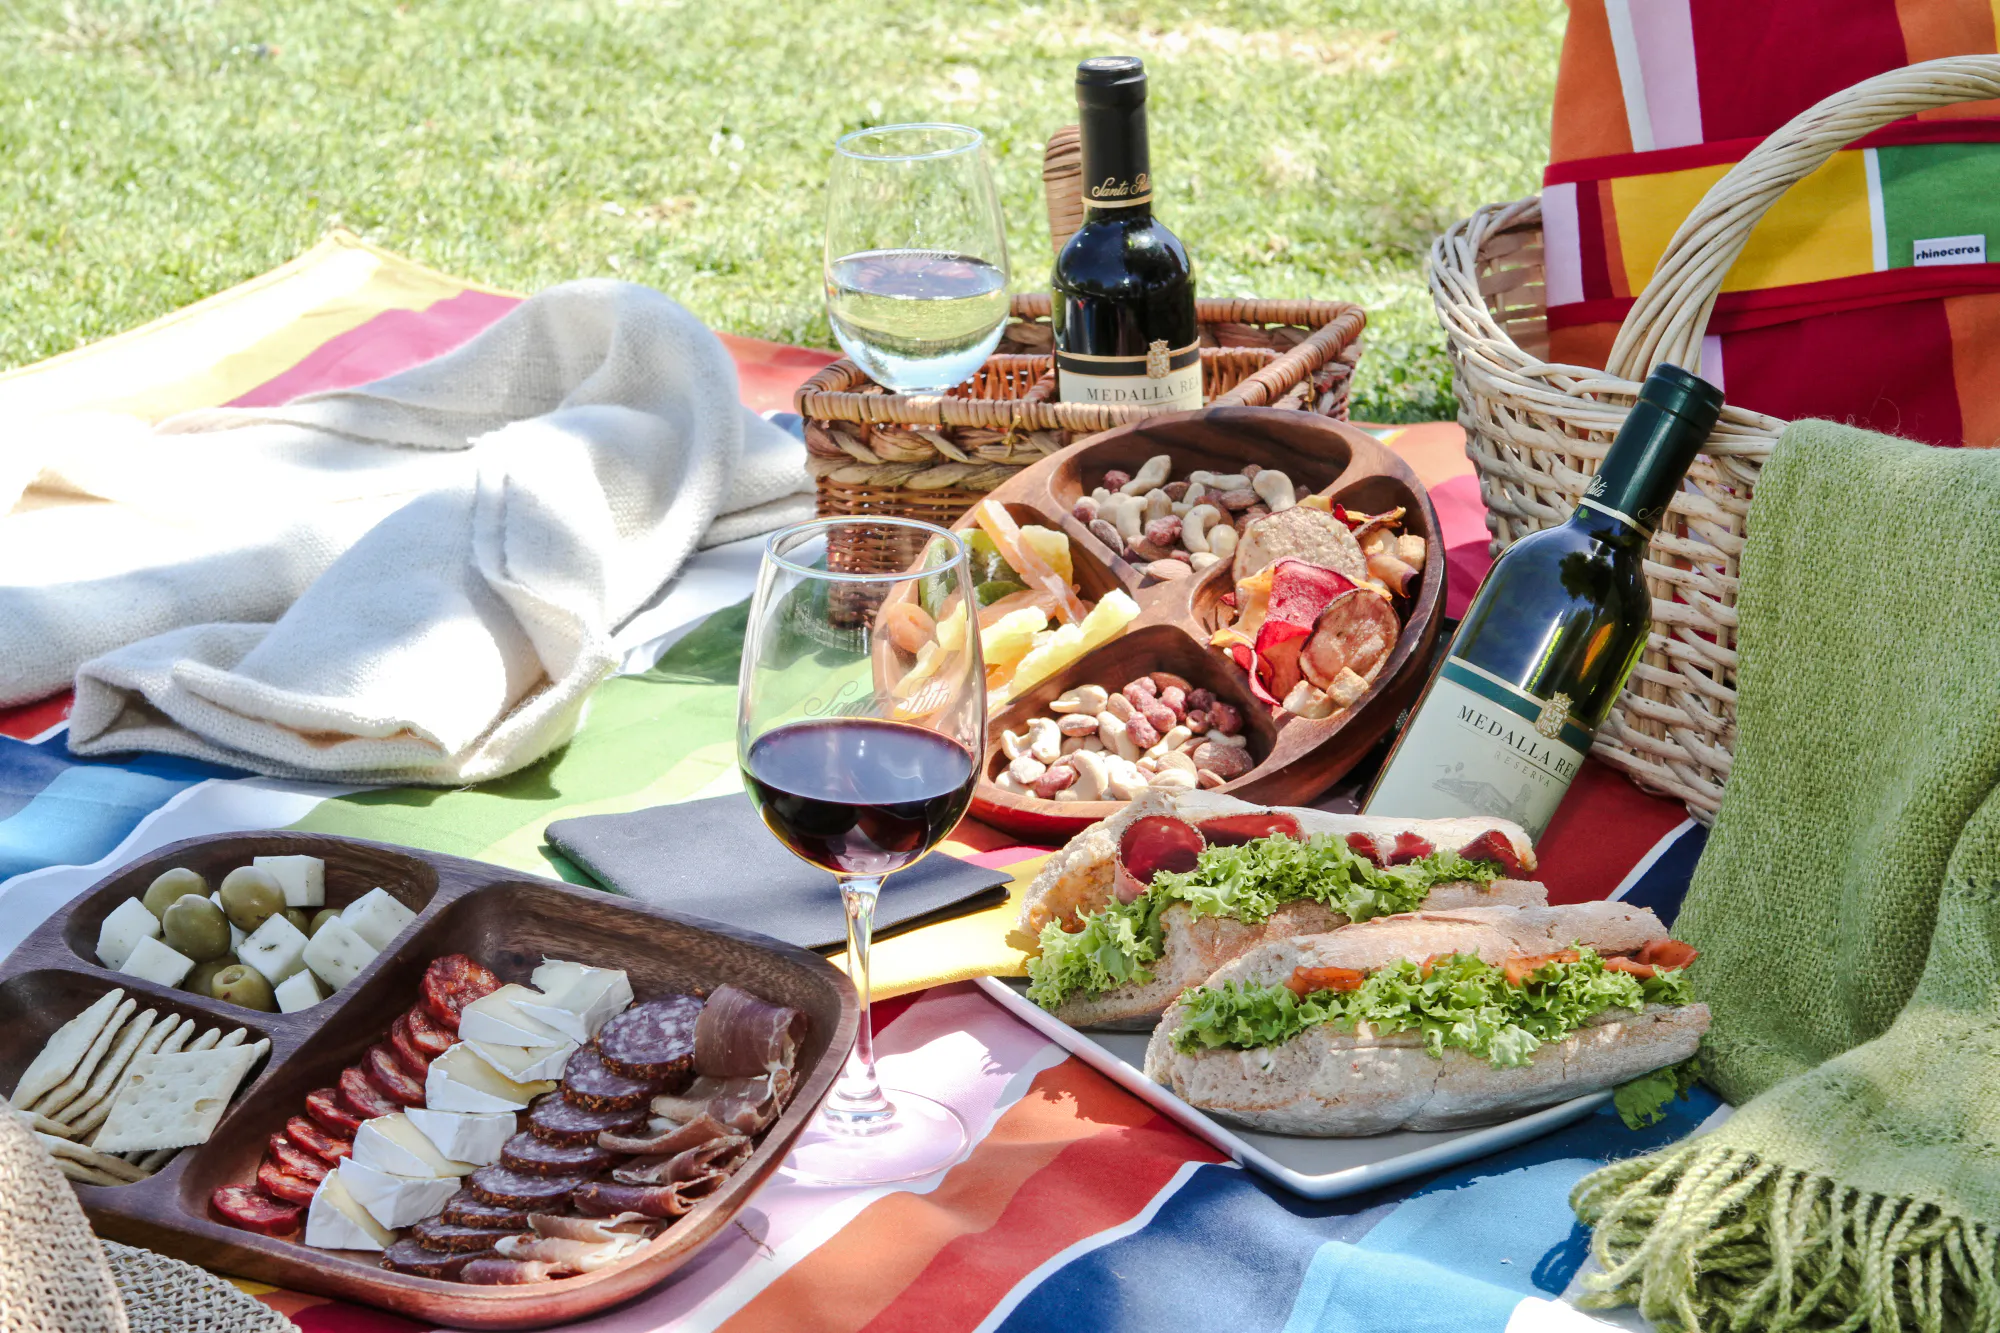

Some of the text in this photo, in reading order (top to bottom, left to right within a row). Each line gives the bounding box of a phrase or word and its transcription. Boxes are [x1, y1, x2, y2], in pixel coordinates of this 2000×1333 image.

[1092, 177, 1128, 197] Santa
[1916, 246, 1980, 260] rhinoceros
[1087, 386, 1174, 401] MEDALLA
[804, 680, 889, 719] Santa
[1457, 705, 1551, 766] MEDALLA
[1494, 750, 1550, 788] RESERVA
